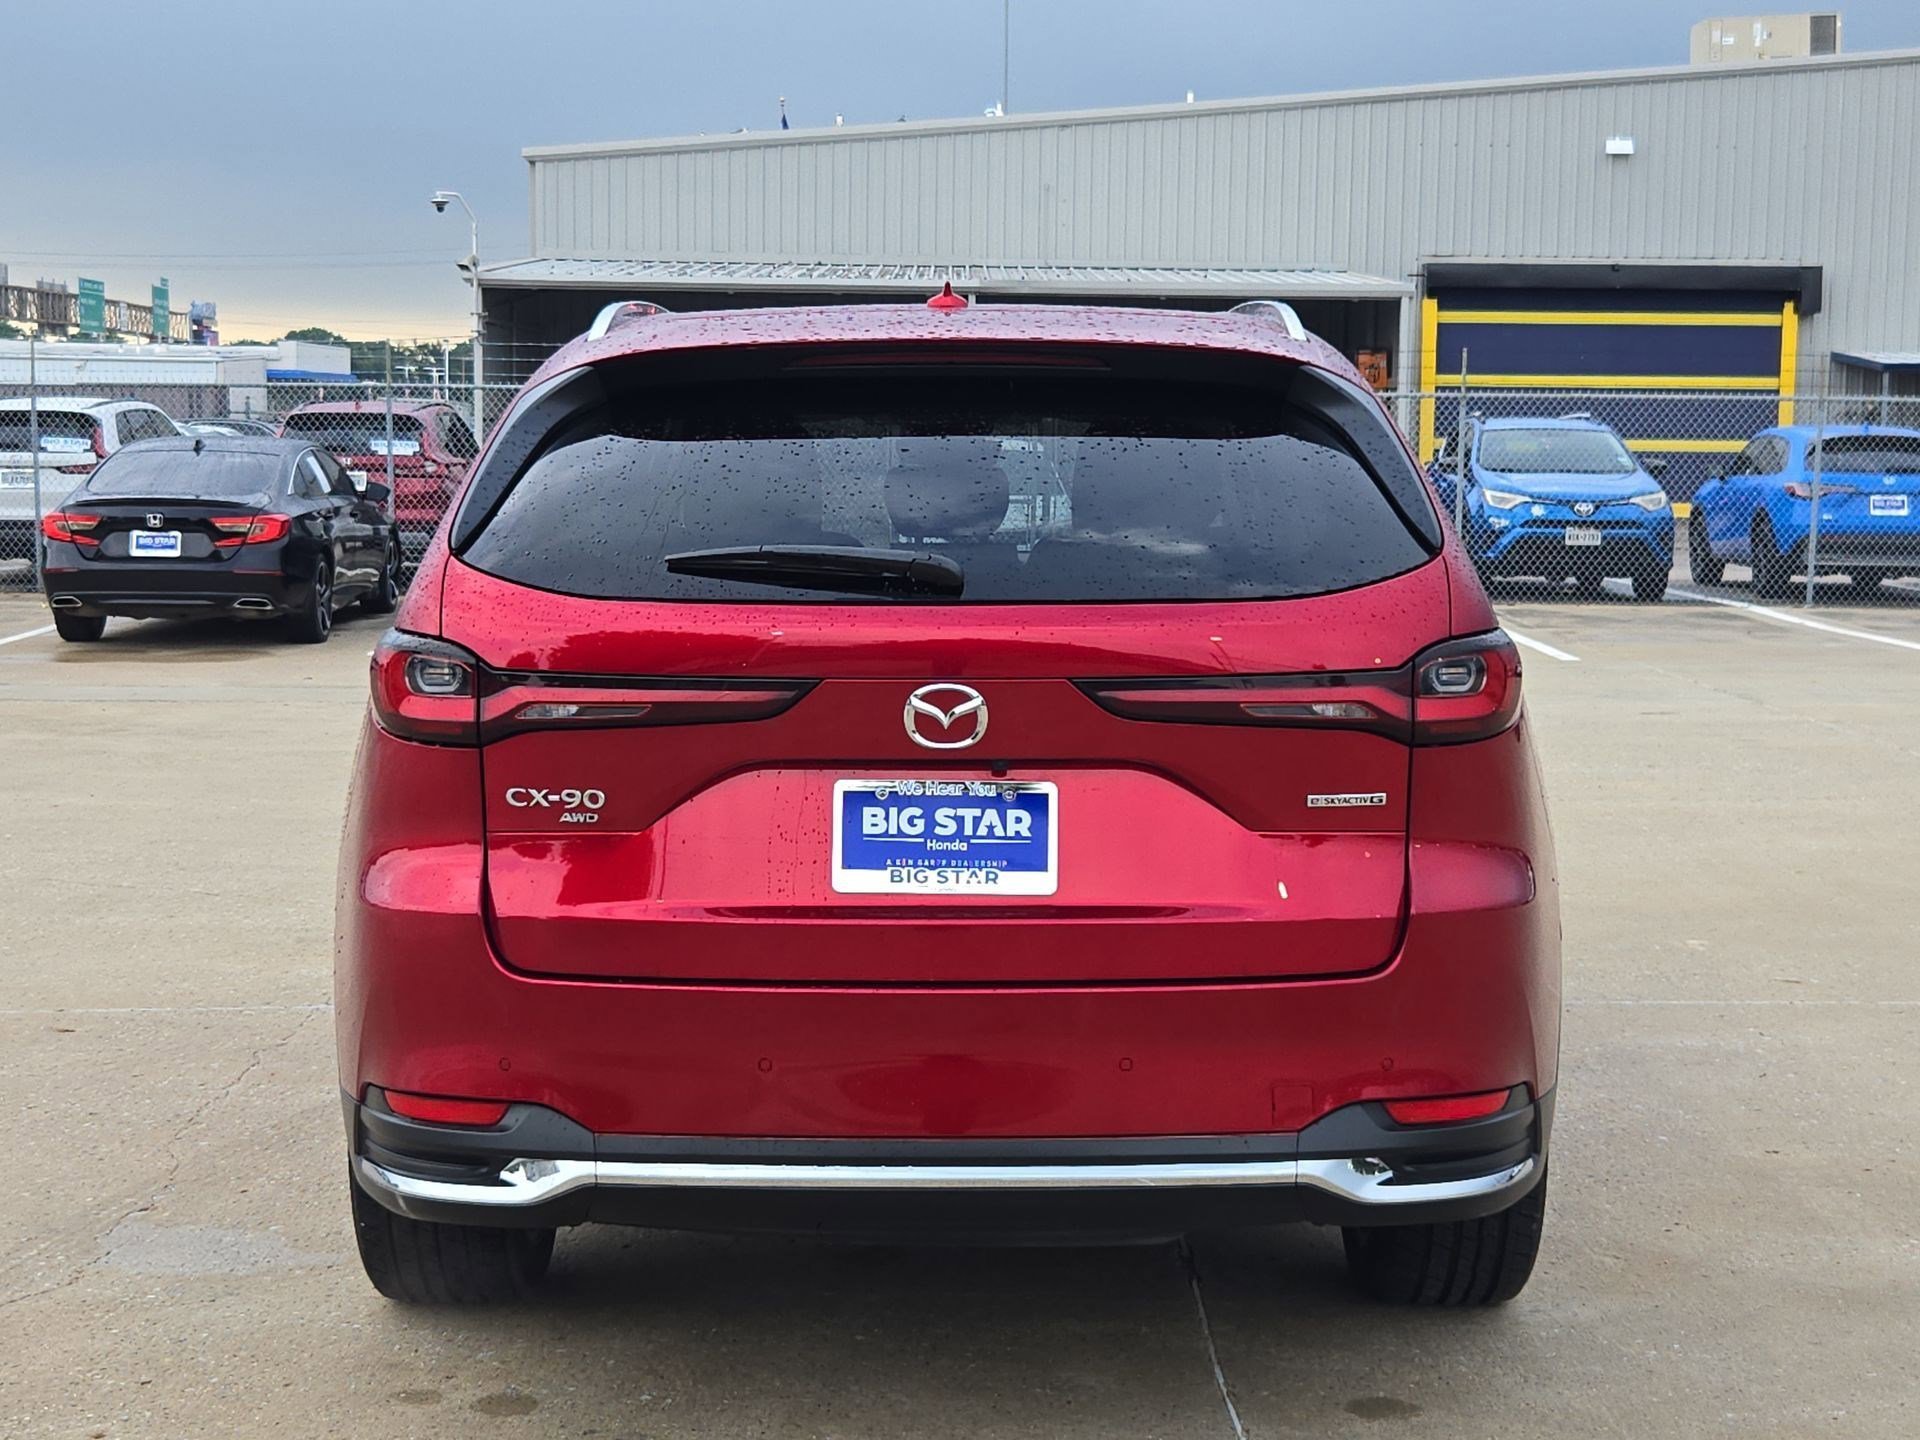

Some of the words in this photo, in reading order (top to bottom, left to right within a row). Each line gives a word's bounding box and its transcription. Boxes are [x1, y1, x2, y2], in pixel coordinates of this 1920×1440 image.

[898, 780, 922, 795] We
[925, 781, 963, 796] Hear
[964, 782, 997, 797] You
[505, 787, 605, 809] CX-90
[559, 812, 599, 823] AWD
[862, 806, 926, 836] BIG
[934, 807, 1032, 838] STAR
[926, 839, 968, 851] Honda
[886, 858, 893, 866] A
[889, 869, 929, 884] BIG
[936, 869, 999, 885] STAR
